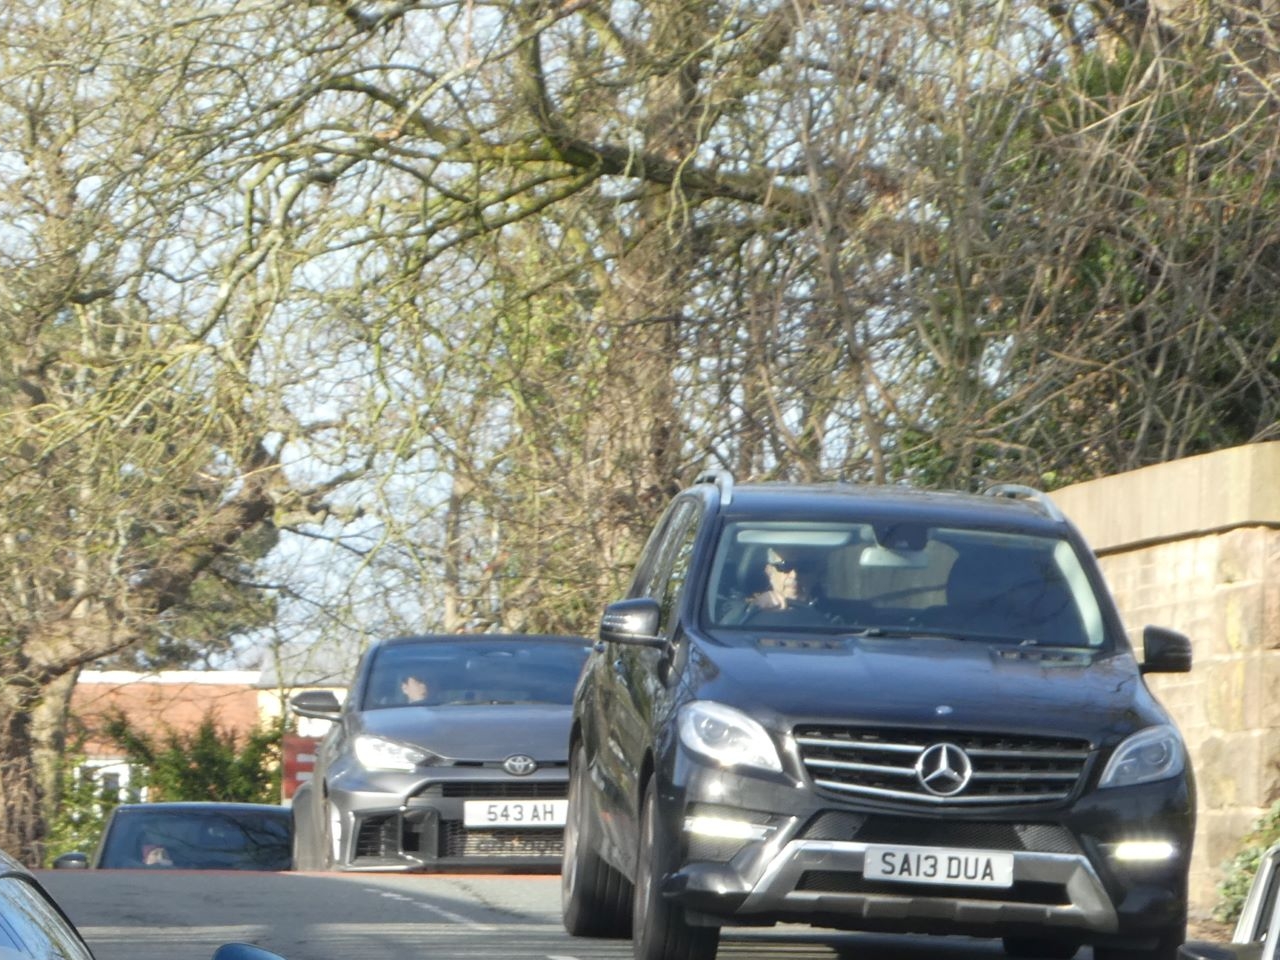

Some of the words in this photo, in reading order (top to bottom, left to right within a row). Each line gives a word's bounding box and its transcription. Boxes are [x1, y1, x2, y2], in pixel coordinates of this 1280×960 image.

[530, 804, 554, 822] AH
[881, 852, 938, 877] SA13
[946, 856, 995, 881] DUA
